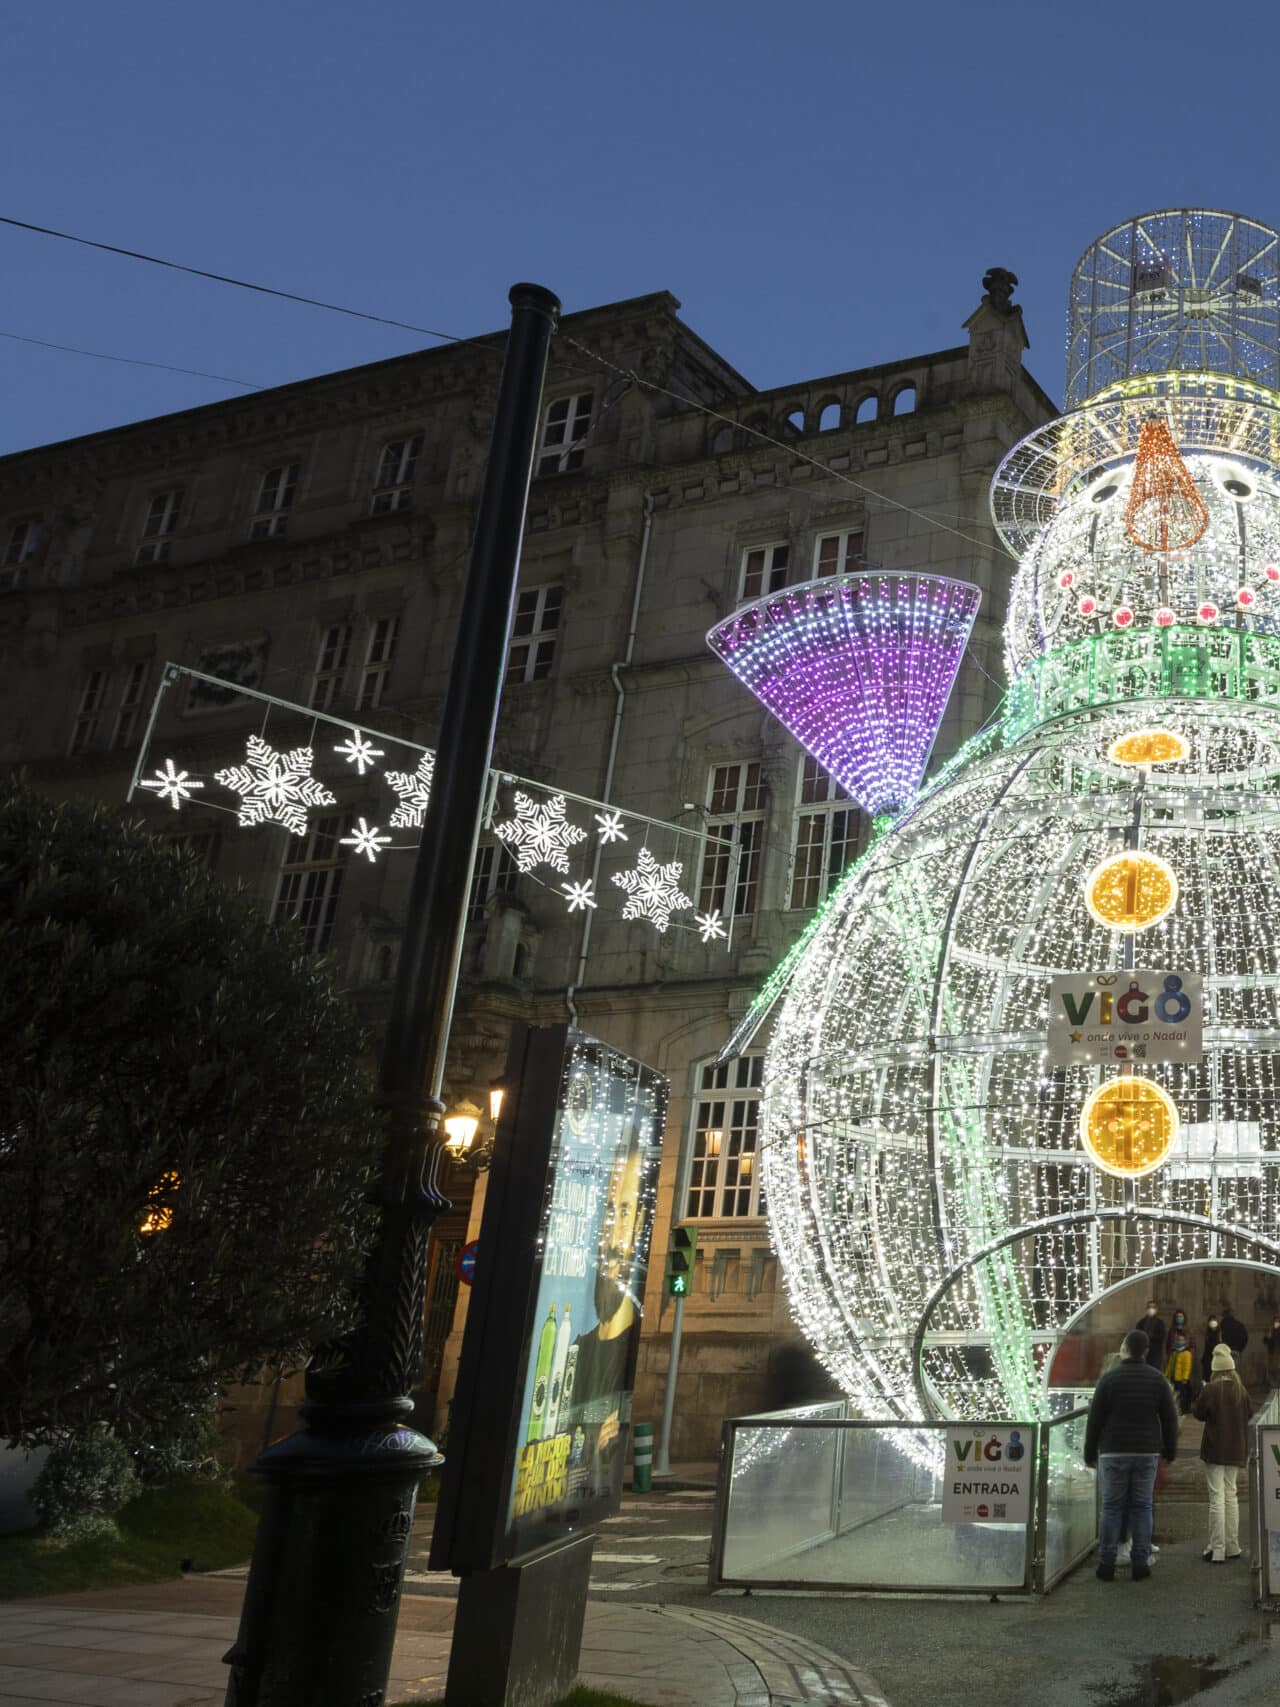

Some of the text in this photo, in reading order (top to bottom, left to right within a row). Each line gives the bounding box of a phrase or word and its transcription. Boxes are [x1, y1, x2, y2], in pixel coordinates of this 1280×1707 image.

[1062, 975, 1191, 1026] VIGO
[1118, 1031, 1140, 1041] vive
[1143, 1033, 1150, 1041] o
[1153, 1031, 1187, 1041] Nadal
[953, 1431, 1024, 1462] VIGO
[953, 1482, 1020, 1495] ENTRADA
